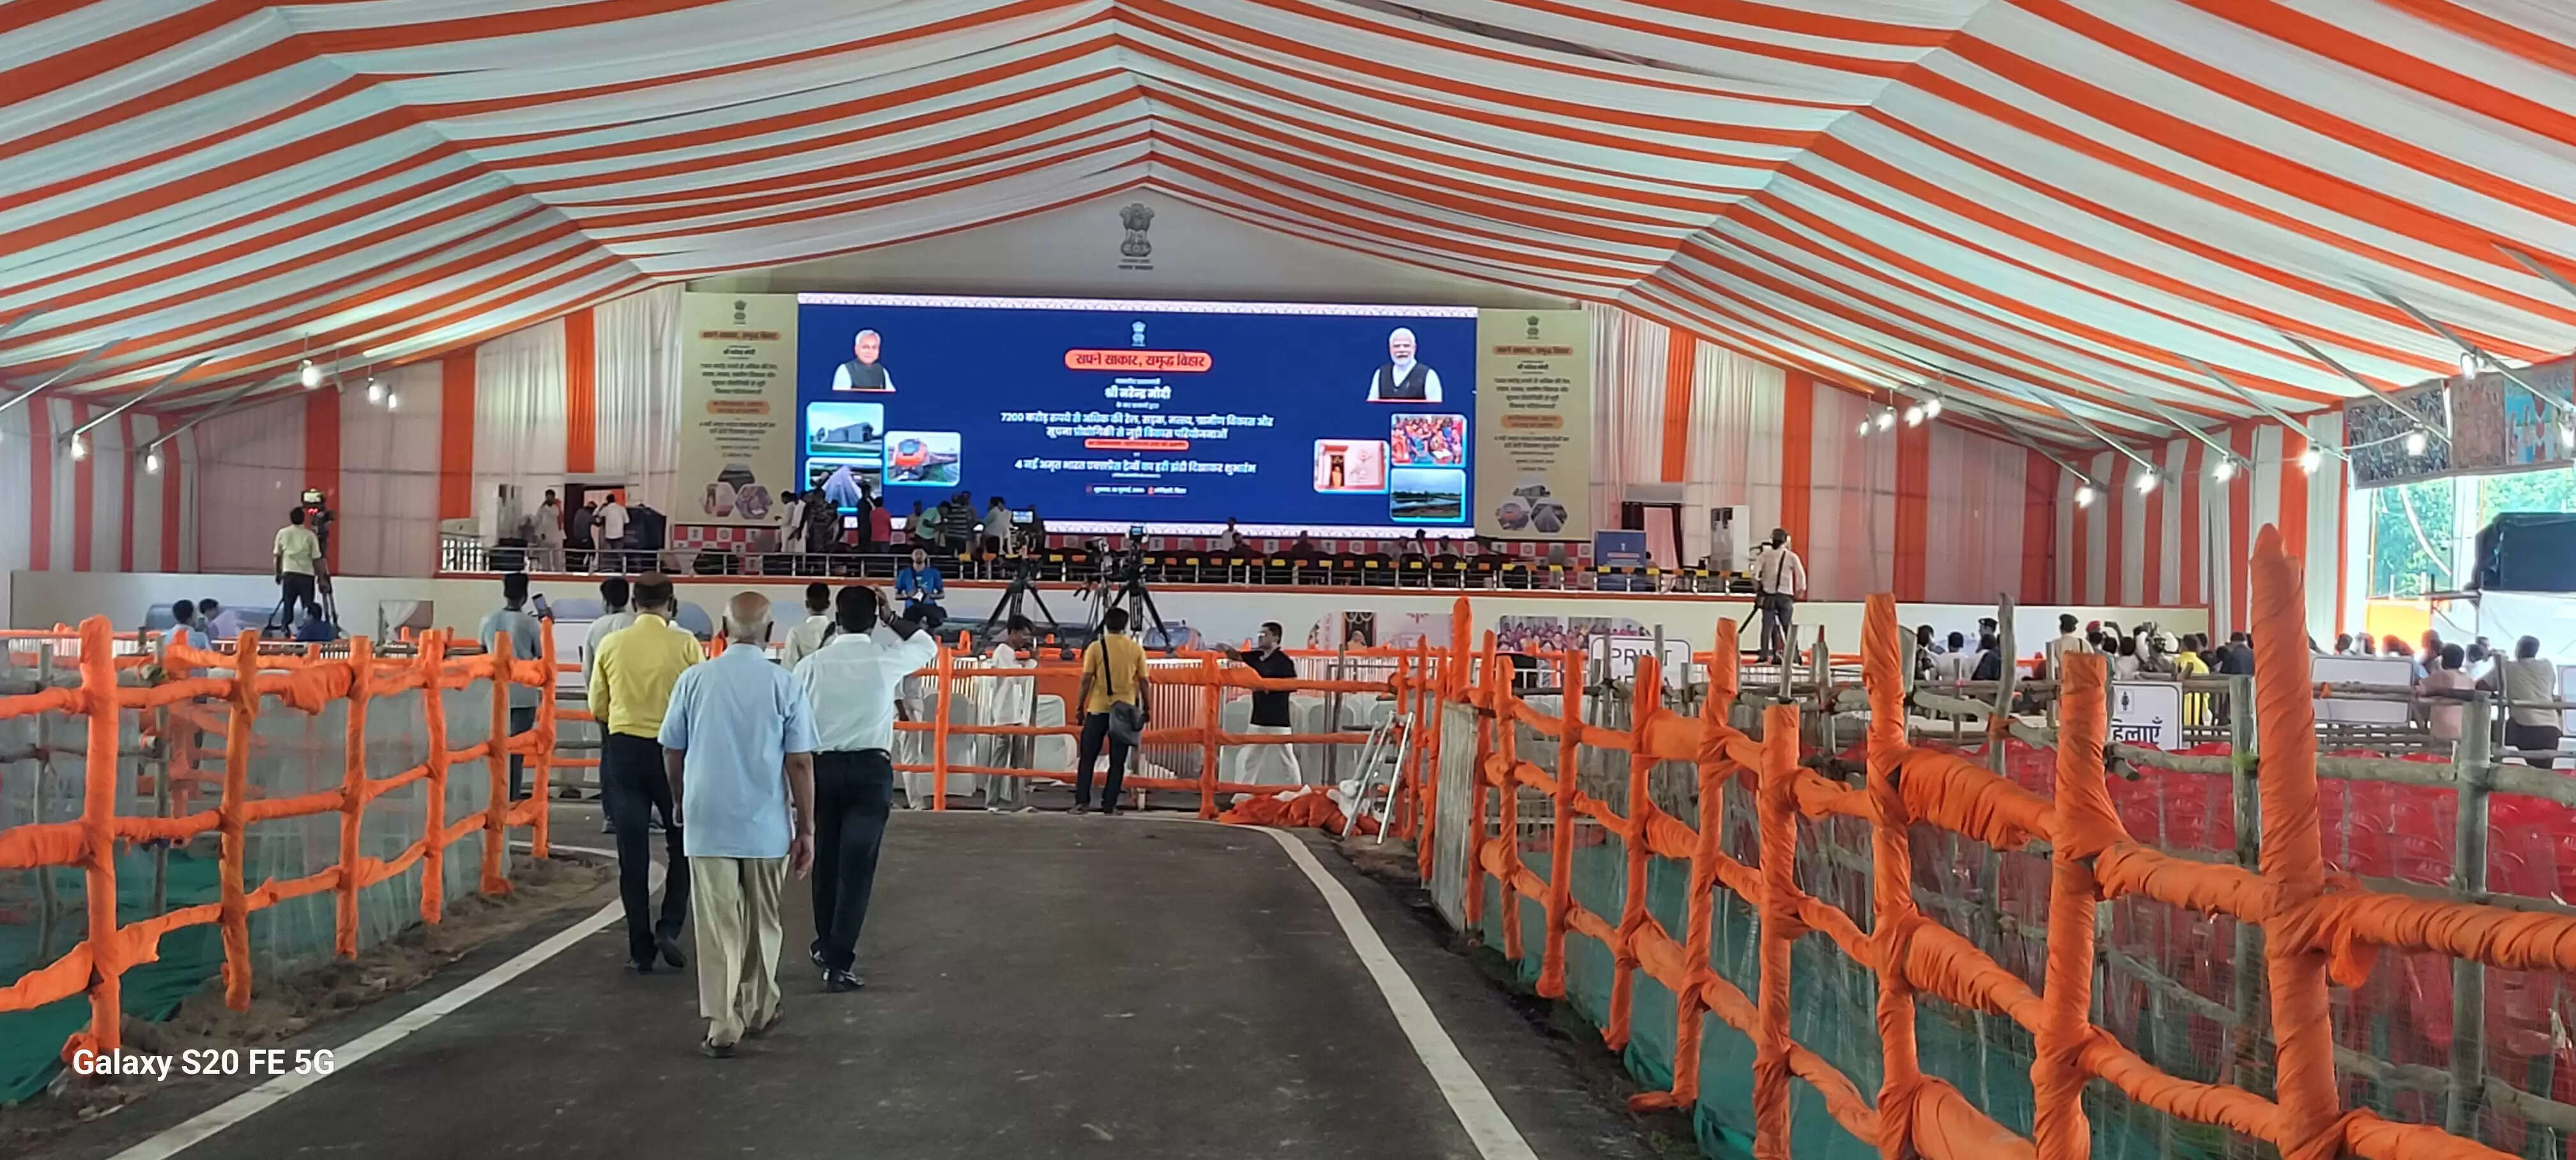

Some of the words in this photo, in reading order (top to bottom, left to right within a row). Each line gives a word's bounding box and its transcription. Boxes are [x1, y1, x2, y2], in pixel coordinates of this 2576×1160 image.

[1076, 353, 1101, 365] सपने
[1105, 353, 1142, 367] साकार,
[1146, 355, 1174, 370] समृद्ध
[1177, 353, 1205, 367] बिहार
[1105, 385, 1118, 398] श्री
[1147, 385, 1172, 399] मोदी
[1000, 413, 1024, 422] 7200
[2110, 716, 2163, 744] हिलाएँ
